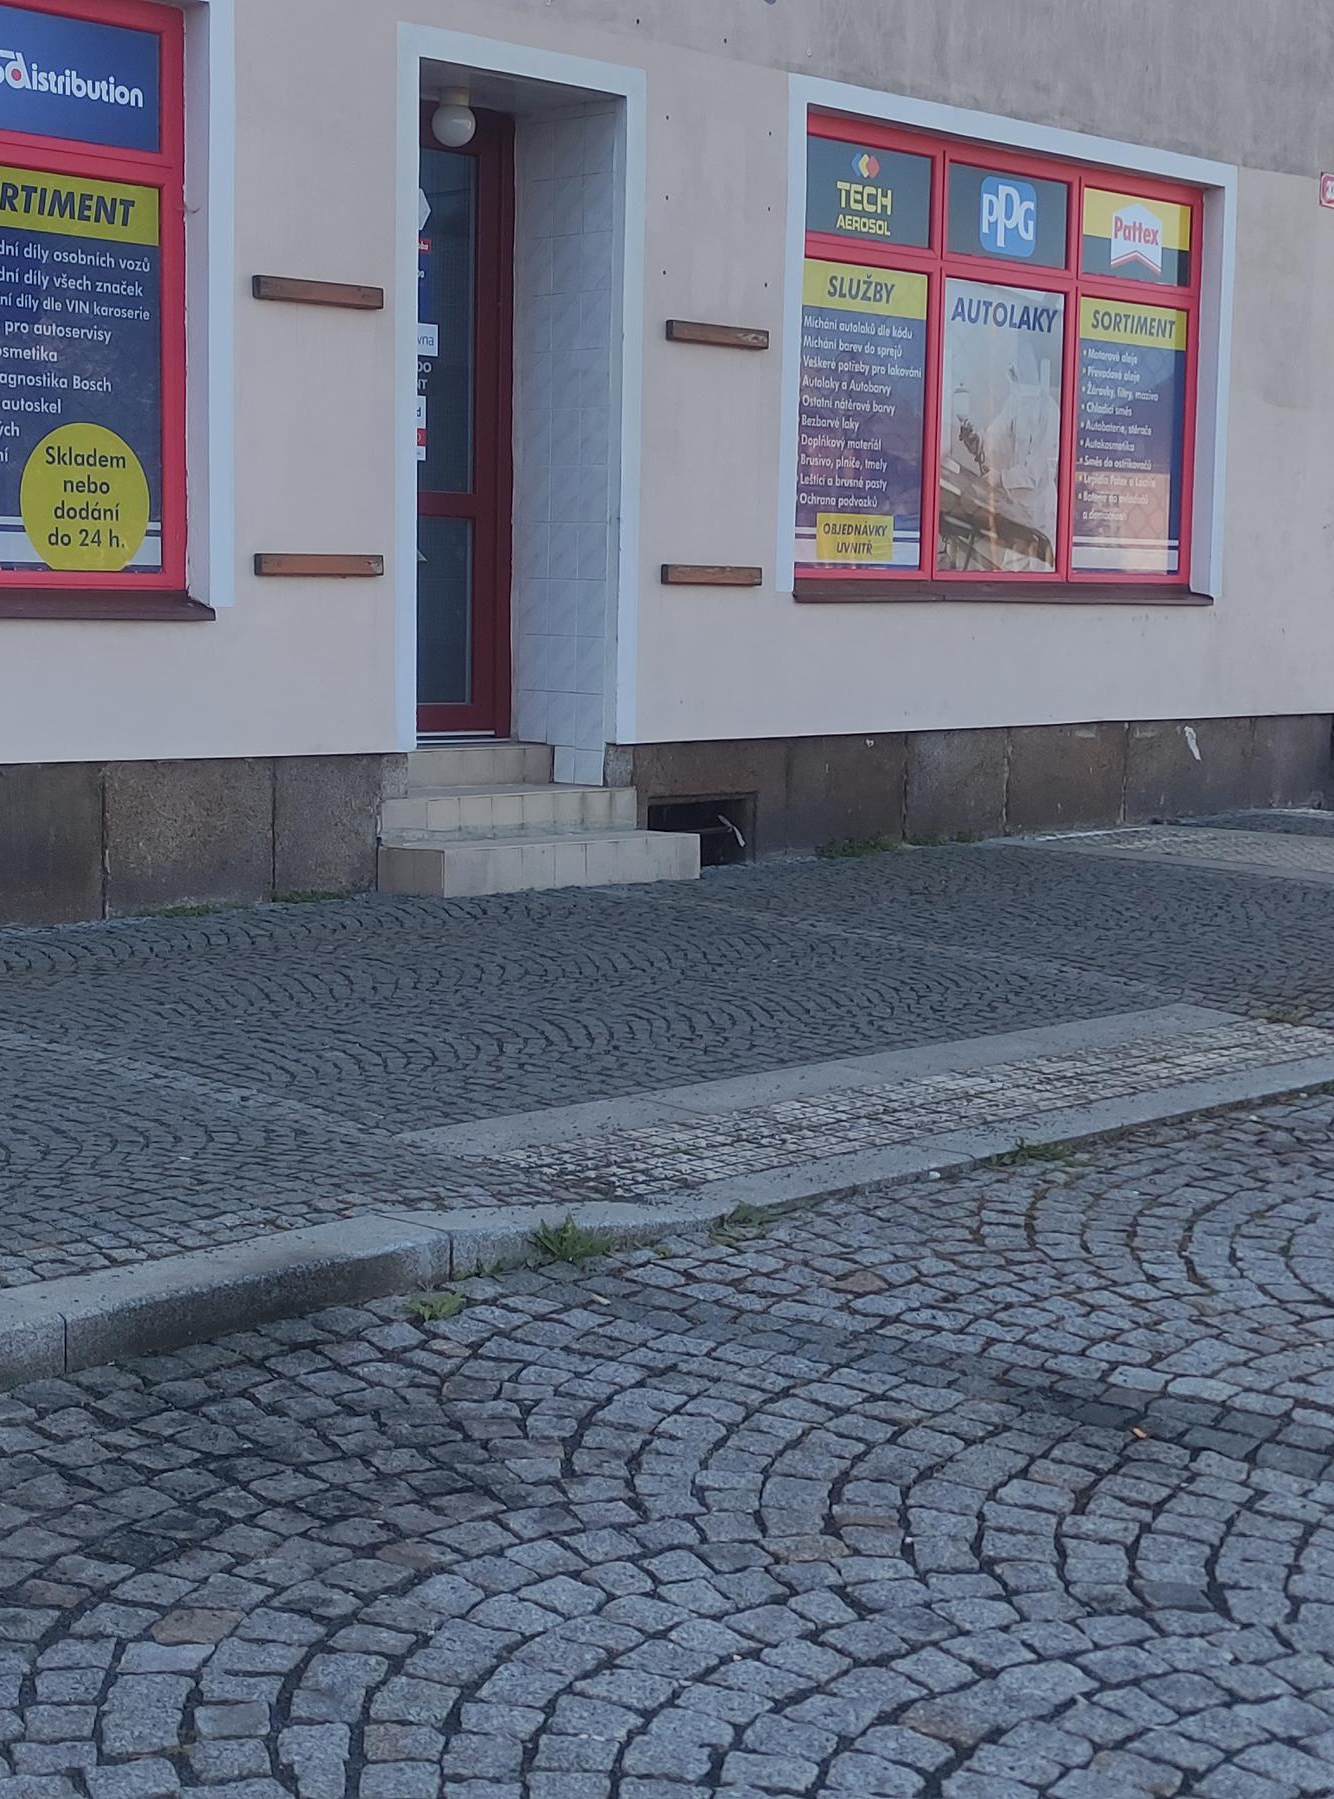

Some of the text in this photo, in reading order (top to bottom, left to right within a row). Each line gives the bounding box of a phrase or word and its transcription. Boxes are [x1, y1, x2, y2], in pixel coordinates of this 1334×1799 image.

[836, 180, 891, 215] TECH
[836, 214, 891, 236] AEROSOL
[982, 184, 1035, 248] PPG
[1114, 216, 1159, 246] Pattex
[23, 243, 49, 263] díly
[53, 250, 114, 268] osobních
[119, 258, 150, 272] vozů
[24, 270, 49, 289] díly
[53, 275, 91, 291] všech
[96, 281, 143, 297] značek
[827, 274, 895, 304] SLUŽBY
[17, 294, 38, 312] díly
[43, 298, 62, 311] dle
[66, 300, 89, 313] VIN
[94, 302, 150, 320] karoserie
[951, 297, 1058, 334] AUTOLAKY
[5, 321, 28, 335] pro
[34, 324, 112, 343] autoservisy
[804, 316, 912, 339] Míchání autolaků dle kódu
[1091, 309, 1175, 339] SORTIMENT
[803, 335, 902, 360] Míchání barev do sprejů
[803, 355, 921, 378] Veškeré potřeby pro lakování
[73, 378, 112, 392] Bosch
[803, 376, 839, 391] Autolaky
[849, 380, 891, 396] Autobarvy
[2, 399, 61, 414] autoskel
[803, 395, 895, 416] Ostatní nátěrové barvy
[802, 415, 859, 432] Bezbarvé laky
[801, 434, 881, 450] Doplňkový materiál
[46, 446, 126, 468] Skladem
[865, 459, 887, 472] tmely
[63, 474, 109, 494] nebo
[801, 474, 825, 485] Leštící
[835, 475, 863, 488] brusné
[866, 480, 887, 491] pasty
[54, 501, 119, 521] dodání
[800, 493, 877, 508] Ochrana podvozků
[48, 529, 125, 548] do 24 h.
[823, 520, 887, 536] OBJEDNÁVKY
[837, 540, 872, 554] UVNITŘ
